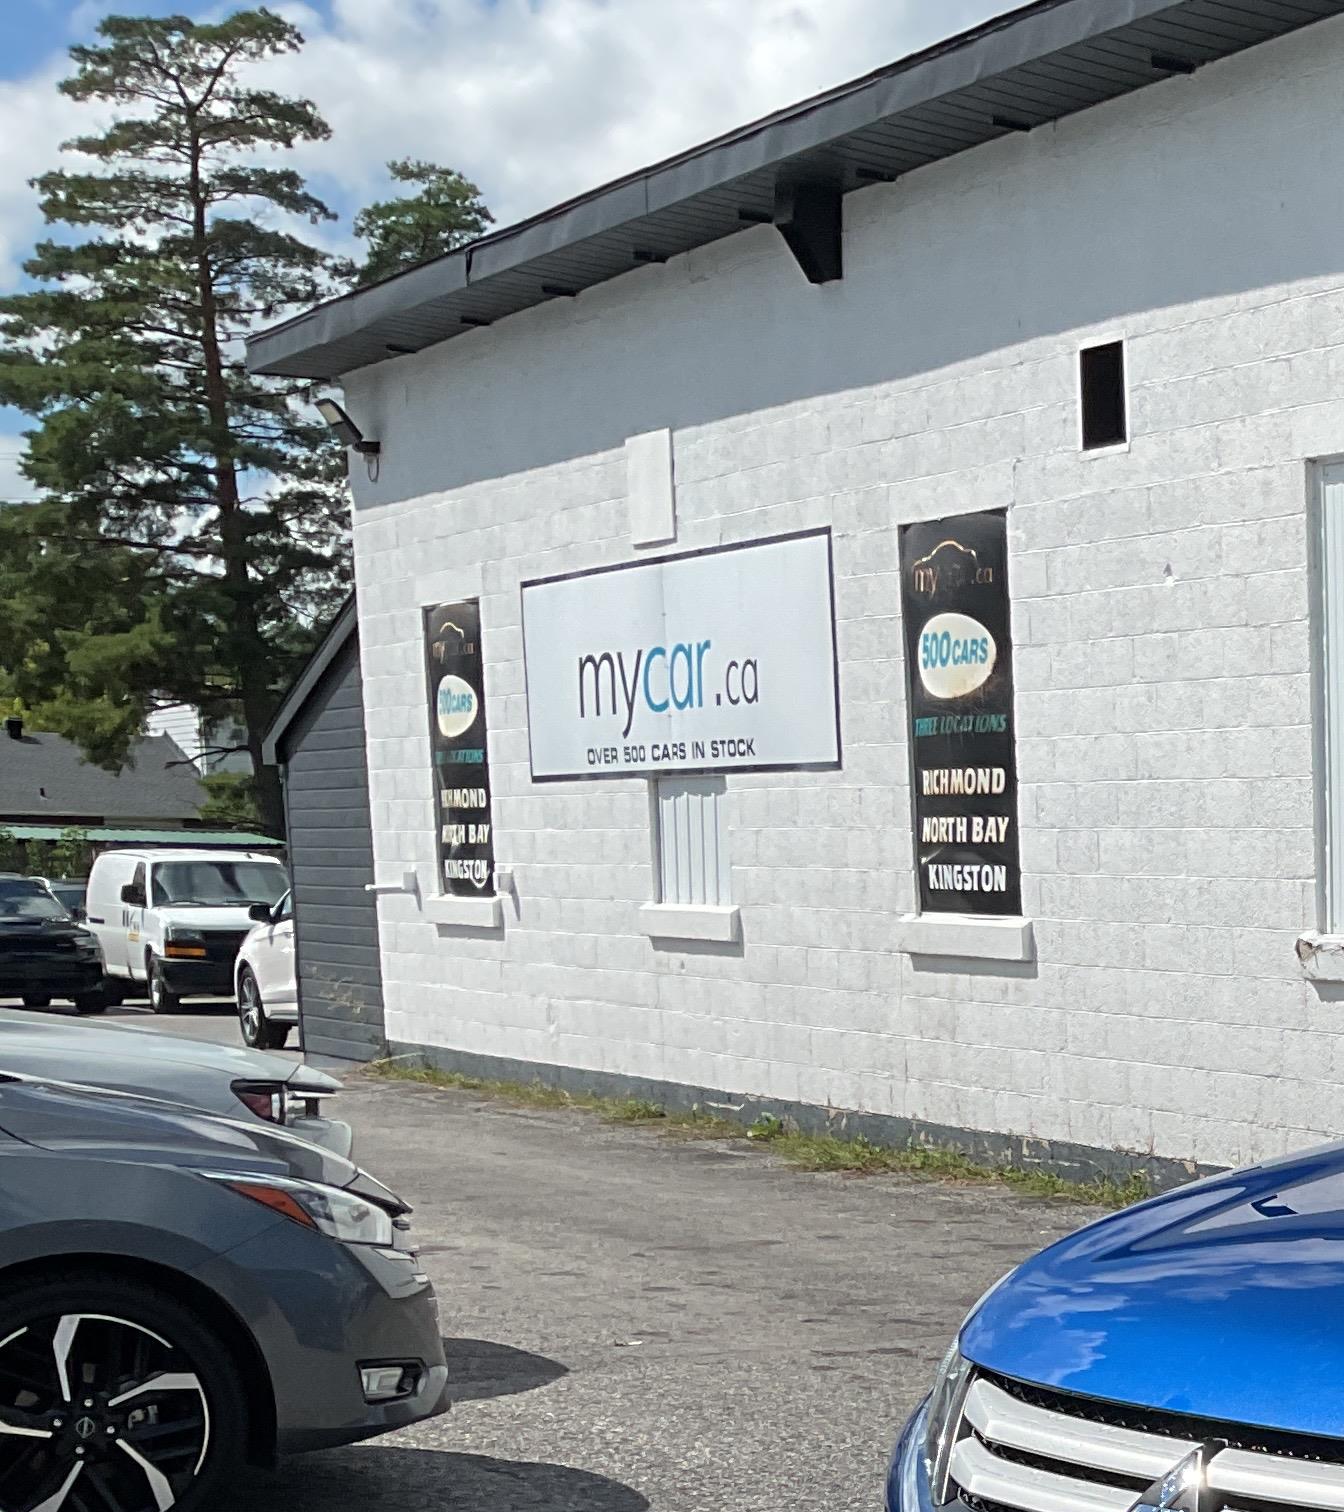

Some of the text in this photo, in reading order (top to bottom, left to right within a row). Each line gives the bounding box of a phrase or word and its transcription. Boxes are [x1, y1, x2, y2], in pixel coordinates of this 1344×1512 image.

[912, 565, 992, 600] my.ca
[578, 639, 759, 739] mycar.ca
[587, 738, 756, 765] OVER 500 CARS IN STOCK
[922, 767, 1006, 796] RICHMOND
[468, 824, 490, 844] BAY
[922, 816, 1010, 843] NORTH BAY
[928, 864, 1007, 892] KINGSTON
